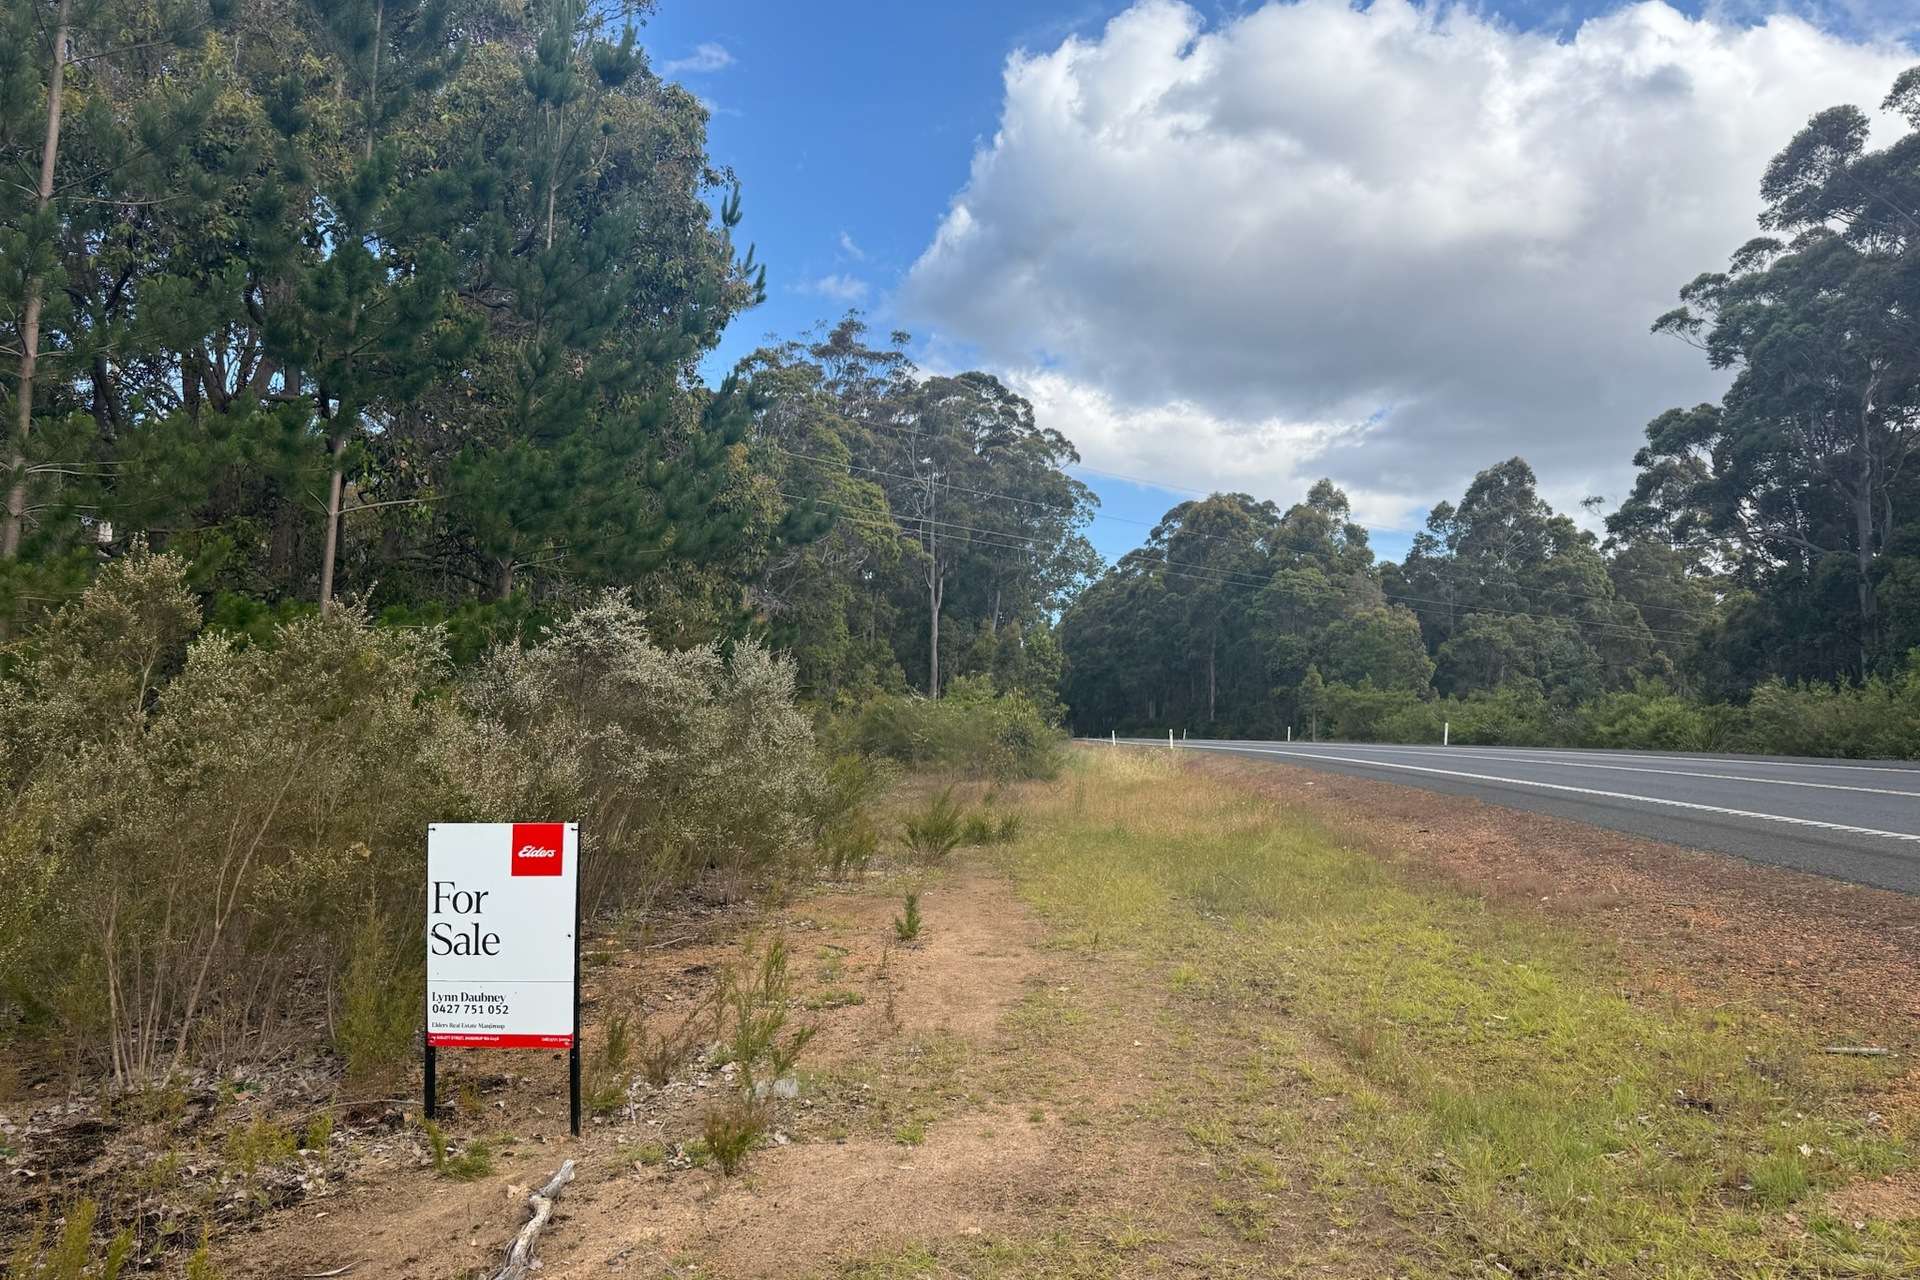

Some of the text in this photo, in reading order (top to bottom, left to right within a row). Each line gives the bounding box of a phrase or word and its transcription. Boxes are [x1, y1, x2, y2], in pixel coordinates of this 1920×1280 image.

[518, 845, 556, 858] Elders
[432, 881, 489, 914] For
[431, 922, 501, 956] Sale
[432, 992, 505, 1005] Lynn Daubney
[432, 1004, 509, 1015] 0427 751 052
